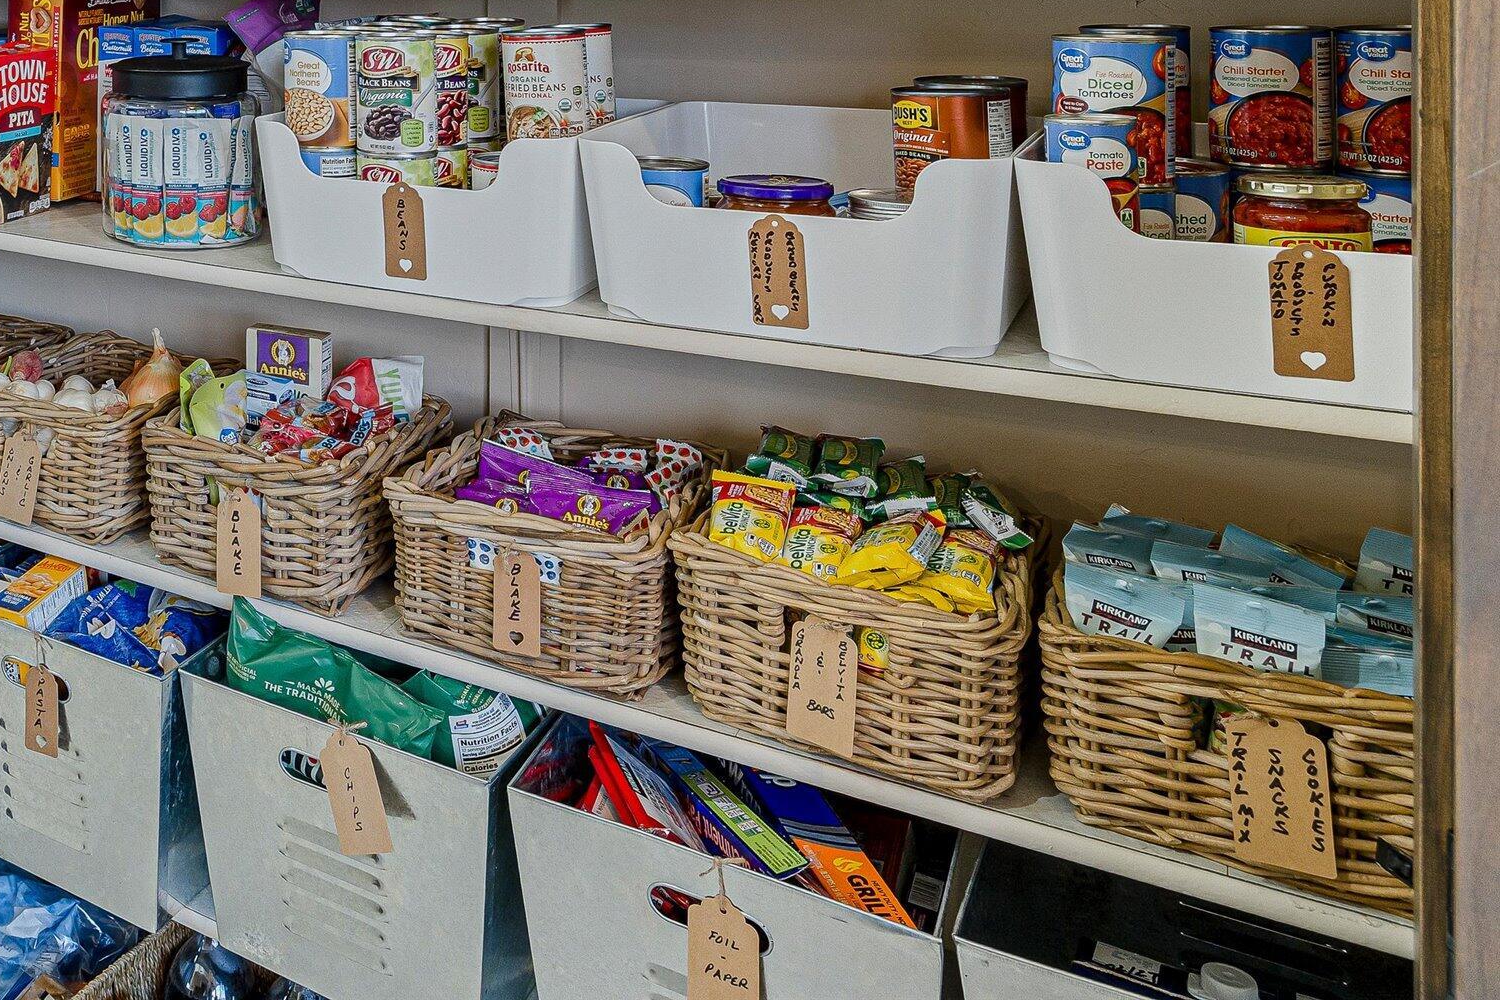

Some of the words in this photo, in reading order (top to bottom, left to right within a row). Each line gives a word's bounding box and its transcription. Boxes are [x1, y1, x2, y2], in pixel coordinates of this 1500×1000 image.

[19, 11, 30, 32] Nut
[103, 12, 129, 26] Honey
[130, 10, 145, 24] Nut
[139, 44, 164, 56] Belgian
[1223, 43, 1245, 51] Great
[1361, 45, 1388, 54] Great
[297, 61, 320, 70] Great
[507, 61, 550, 74] Rosarita
[1060, 53, 1084, 63] Great
[1065, 61, 1085, 69] Value
[289, 69, 321, 79] Northern
[1221, 75, 1251, 83] Seasoned
[1252, 75, 1282, 83] Crushed
[1222, 65, 1244, 75] Chili
[1246, 66, 1286, 76] Starter
[1360, 68, 1387, 79] Chili
[296, 78, 321, 87] Beans
[359, 78, 381, 88] BLACK
[382, 78, 411, 88] BEANS
[442, 80, 466, 89] BEANS
[532, 83, 567, 92] BEANS
[1087, 78, 1134, 91] Diced
[1358, 78, 1395, 87] Seasoned
[360, 91, 409, 108] Organic
[1077, 88, 1134, 100] Tomatoes
[8, 109, 35, 128] PITA
[893, 106, 928, 123] BUSH'S
[893, 129, 934, 143] Original
[1061, 134, 1085, 143] Great
[321, 156, 345, 165] Nutrition
[908, 151, 931, 160] BEANS
[1088, 151, 1124, 159] Tomato
[1236, 148, 1258, 159] (425g)
[1358, 153, 1367, 161] 15
[1367, 154, 1377, 163] OZ
[1378, 156, 1403, 166] (425g)
[1086, 159, 1124, 171] Paste
[396, 199, 410, 251] BEANS
[1175, 213, 1207, 225] shed
[1371, 212, 1412, 223] Starter
[749, 231, 761, 280] MEXICAN
[785, 231, 797, 268] BAKED
[764, 230, 775, 293] PRODUCTS
[789, 271, 800, 312] BEANS
[1269, 260, 1290, 320] TOMATO
[1290, 262, 1306, 337] PRODUCTS
[1321, 262, 1338, 327] PUMPKIN
[260, 362, 308, 382] Annie's
[0, 448, 15, 496] ONIONS
[19, 456, 35, 507] GARLIC
[562, 511, 610, 530] Annie's
[720, 501, 743, 535] belVita
[231, 510, 243, 576] BLAKE
[1088, 555, 1133, 569] KIRKLAND
[507, 563, 521, 623] BLAKE
[1096, 602, 1149, 626] KIRKLAND
[1081, 612, 1153, 646] TRAIL
[1234, 629, 1295, 652] KIRKLAND
[792, 628, 805, 690] GRANOLA
[1220, 642, 1315, 678] TRAIL
[835, 641, 848, 701] BELVITA
[33, 678, 46, 729] PASTA
[264, 681, 283, 694] THE
[285, 686, 341, 723] TRADITIONAL
[297, 681, 322, 696] MASA
[323, 692, 341, 711] MADE
[806, 699, 835, 720] BARS
[460, 732, 500, 747] Nutrition
[500, 720, 518, 738] Facts
[464, 762, 499, 773] Calories
[1231, 731, 1249, 796] TRAIL
[343, 766, 363, 832] CHIPS
[1267, 748, 1291, 836] SNACKS
[1301, 748, 1325, 853] COOKIES
[1237, 803, 1255, 843] MIX
[708, 930, 740, 951] FOIL
[704, 963, 749, 990] PAPER
